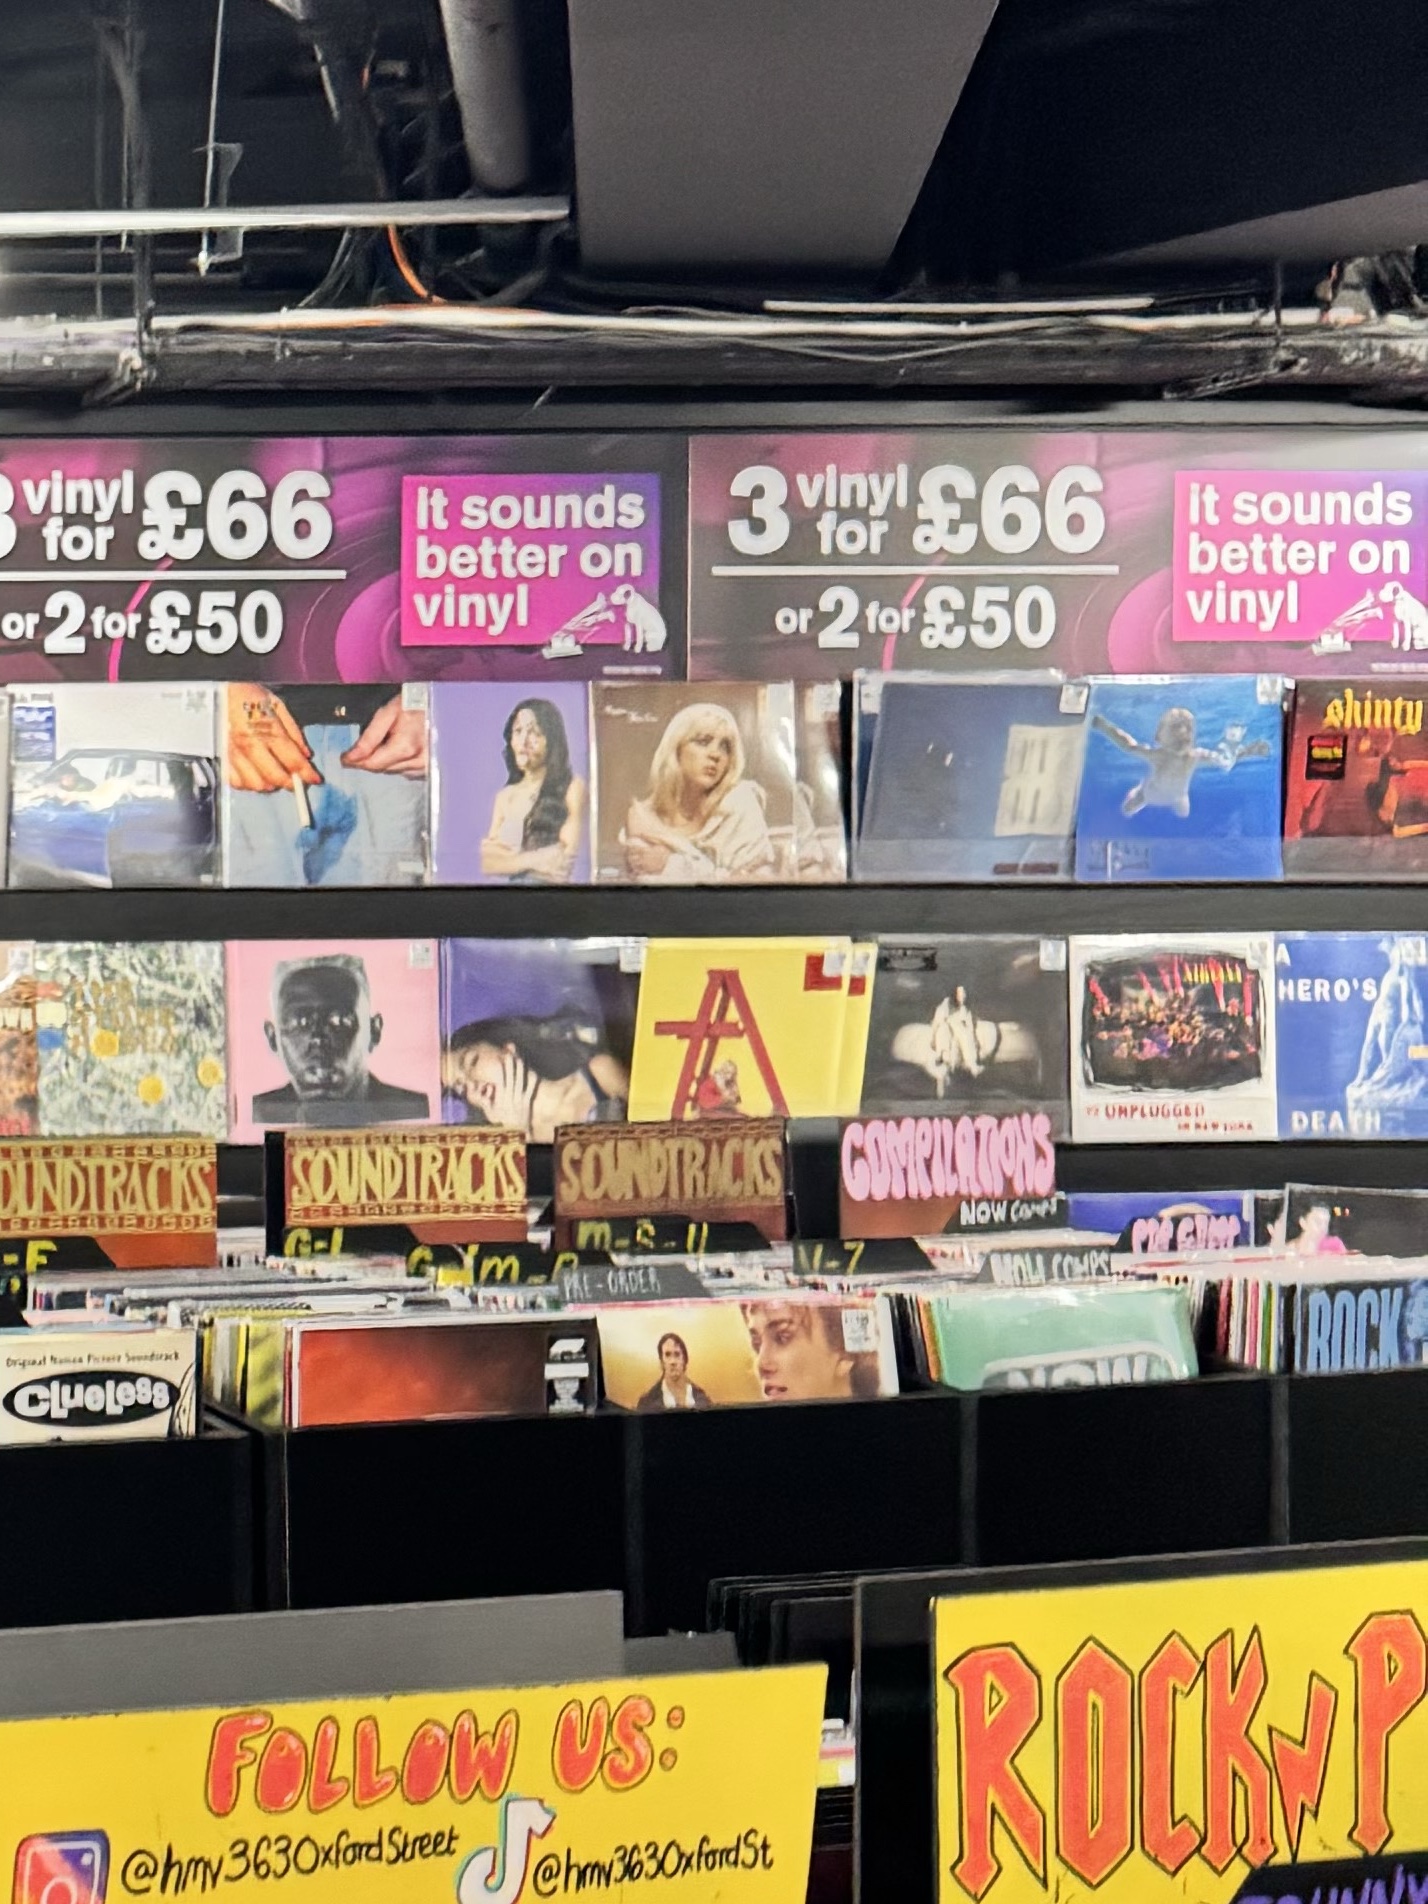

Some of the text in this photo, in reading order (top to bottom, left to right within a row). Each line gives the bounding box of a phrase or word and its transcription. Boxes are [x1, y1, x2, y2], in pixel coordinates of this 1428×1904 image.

[22, 470, 133, 523] vinyl
[137, 470, 335, 562] £66
[416, 484, 646, 531] it sounds
[728, 463, 1105, 555] 3 vinyl for £66
[1189, 483, 1413, 526] it sounds
[42, 517, 115, 562] for
[416, 534, 643, 581] better on
[1188, 532, 1411, 576] better on
[0, 590, 284, 656] or 2 for £50
[414, 584, 530, 637] vinyl
[775, 586, 1056, 649] or 2 for £50
[1186, 581, 1298, 632] vinyl
[1276, 944, 1291, 966] A
[1278, 978, 1378, 1002] HERO'S
[1291, 1110, 1381, 1134] DEATH
[291, 1141, 526, 1205] SOUNDTRACKS
[559, 1137, 783, 1199] SOUNDTRACKS
[842, 1112, 1055, 1200] COMPILATIONS
[960, 1199, 1006, 1225] NOW
[1308, 1289, 1403, 1374] ROCK
[205, 1696, 685, 1816] FOLLOW US:
[945, 1625, 1278, 1904] ROCK
